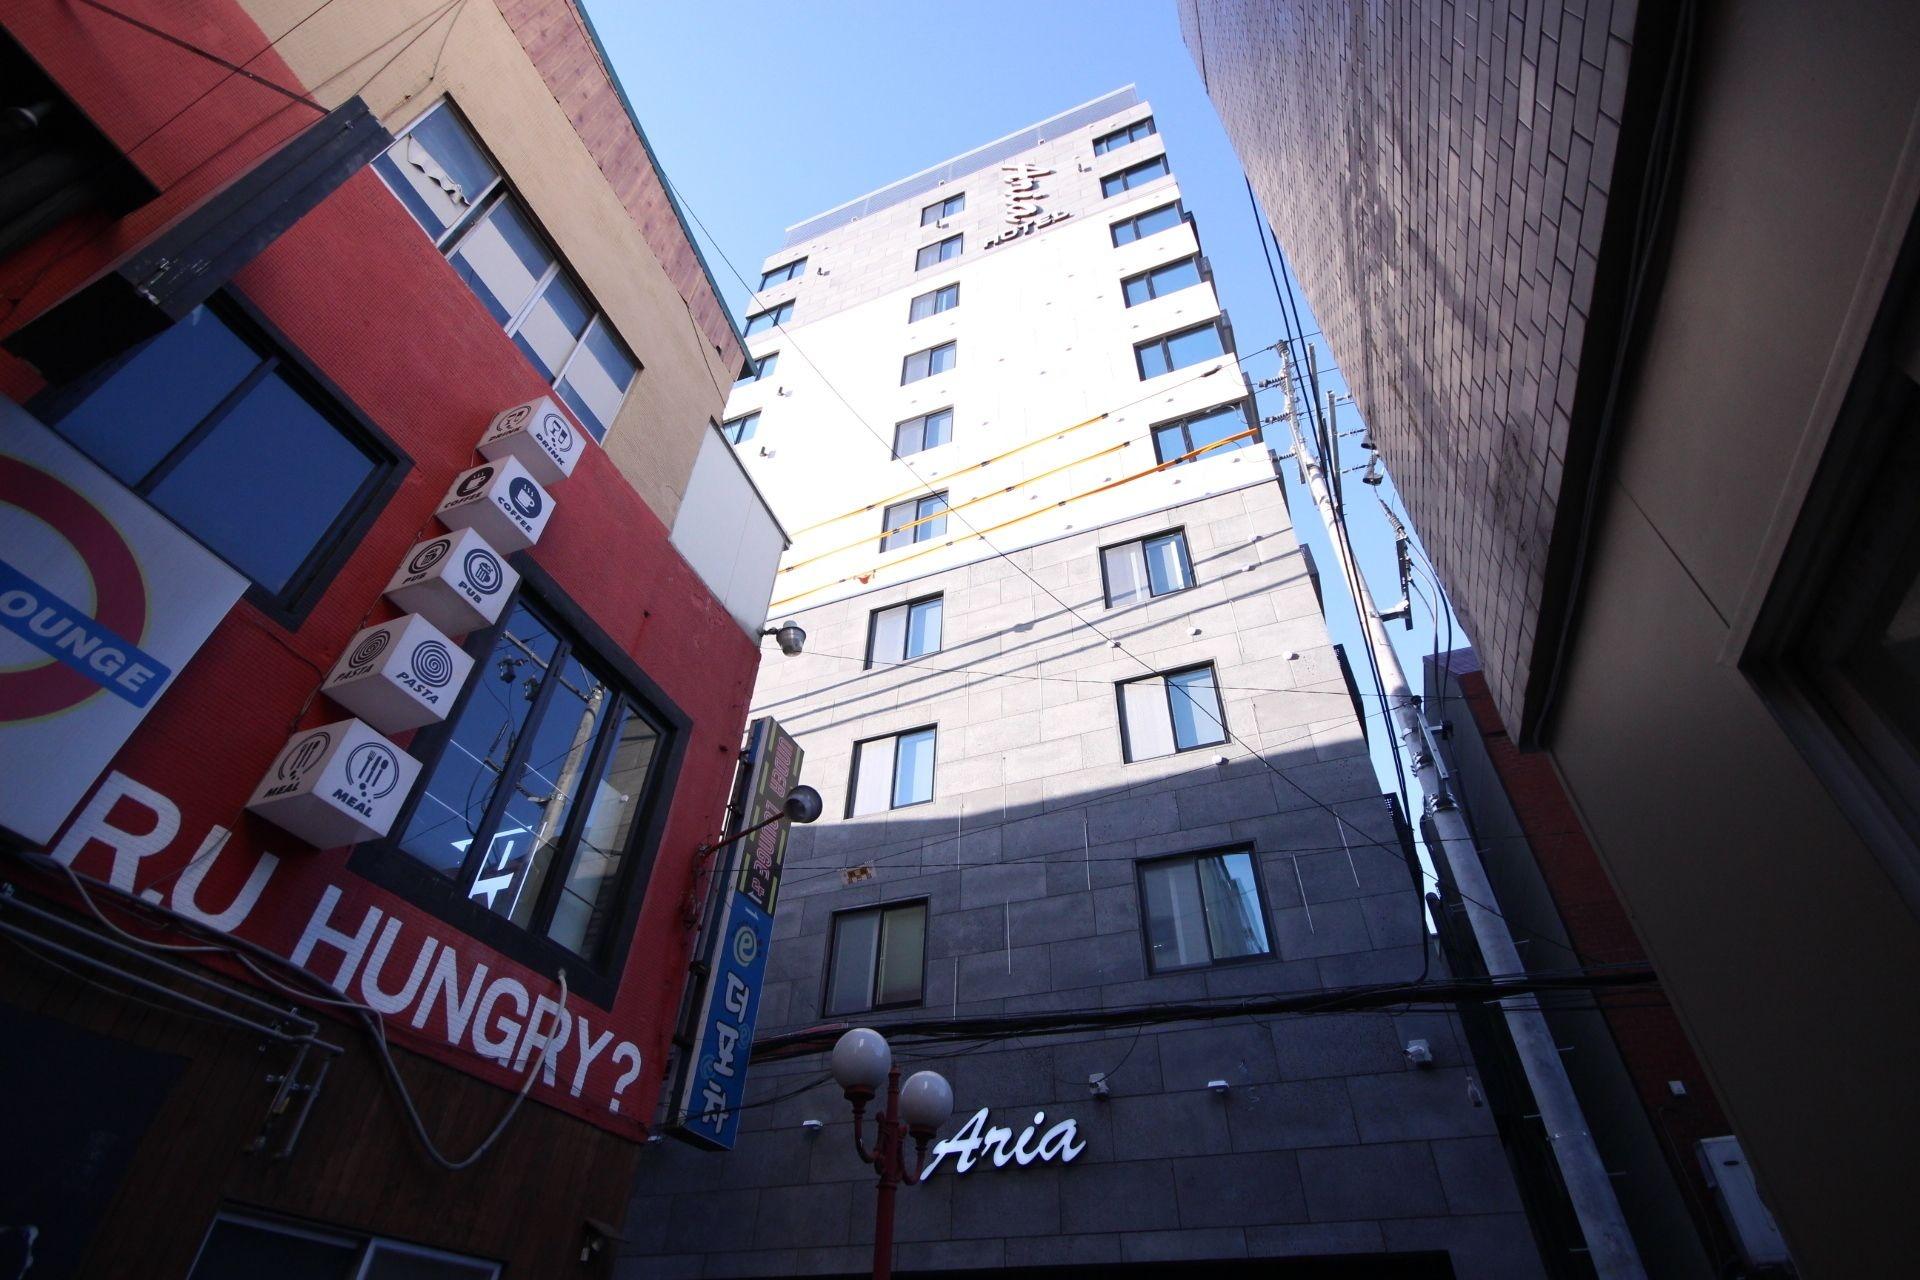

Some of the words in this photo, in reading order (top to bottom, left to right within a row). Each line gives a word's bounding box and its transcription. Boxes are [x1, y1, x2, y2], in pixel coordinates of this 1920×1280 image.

[982, 212, 1075, 250] HOTEL
[535, 432, 566, 466] DRINK
[444, 491, 485, 509] COFFEE
[497, 496, 533, 533] COFFEE
[402, 572, 427, 585] PUB
[458, 580, 482, 604] PUB
[333, 664, 375, 683] PASTA
[396, 671, 439, 705] PASTA
[769, 736, 794, 799] UNDER
[262, 782, 301, 799] MEAL
[332, 788, 373, 818] MEAL
[753, 799, 785, 881] LOUNGE
[289, 884, 642, 1113] HUNGRY?
[920, 1107, 1087, 1181] Aria
